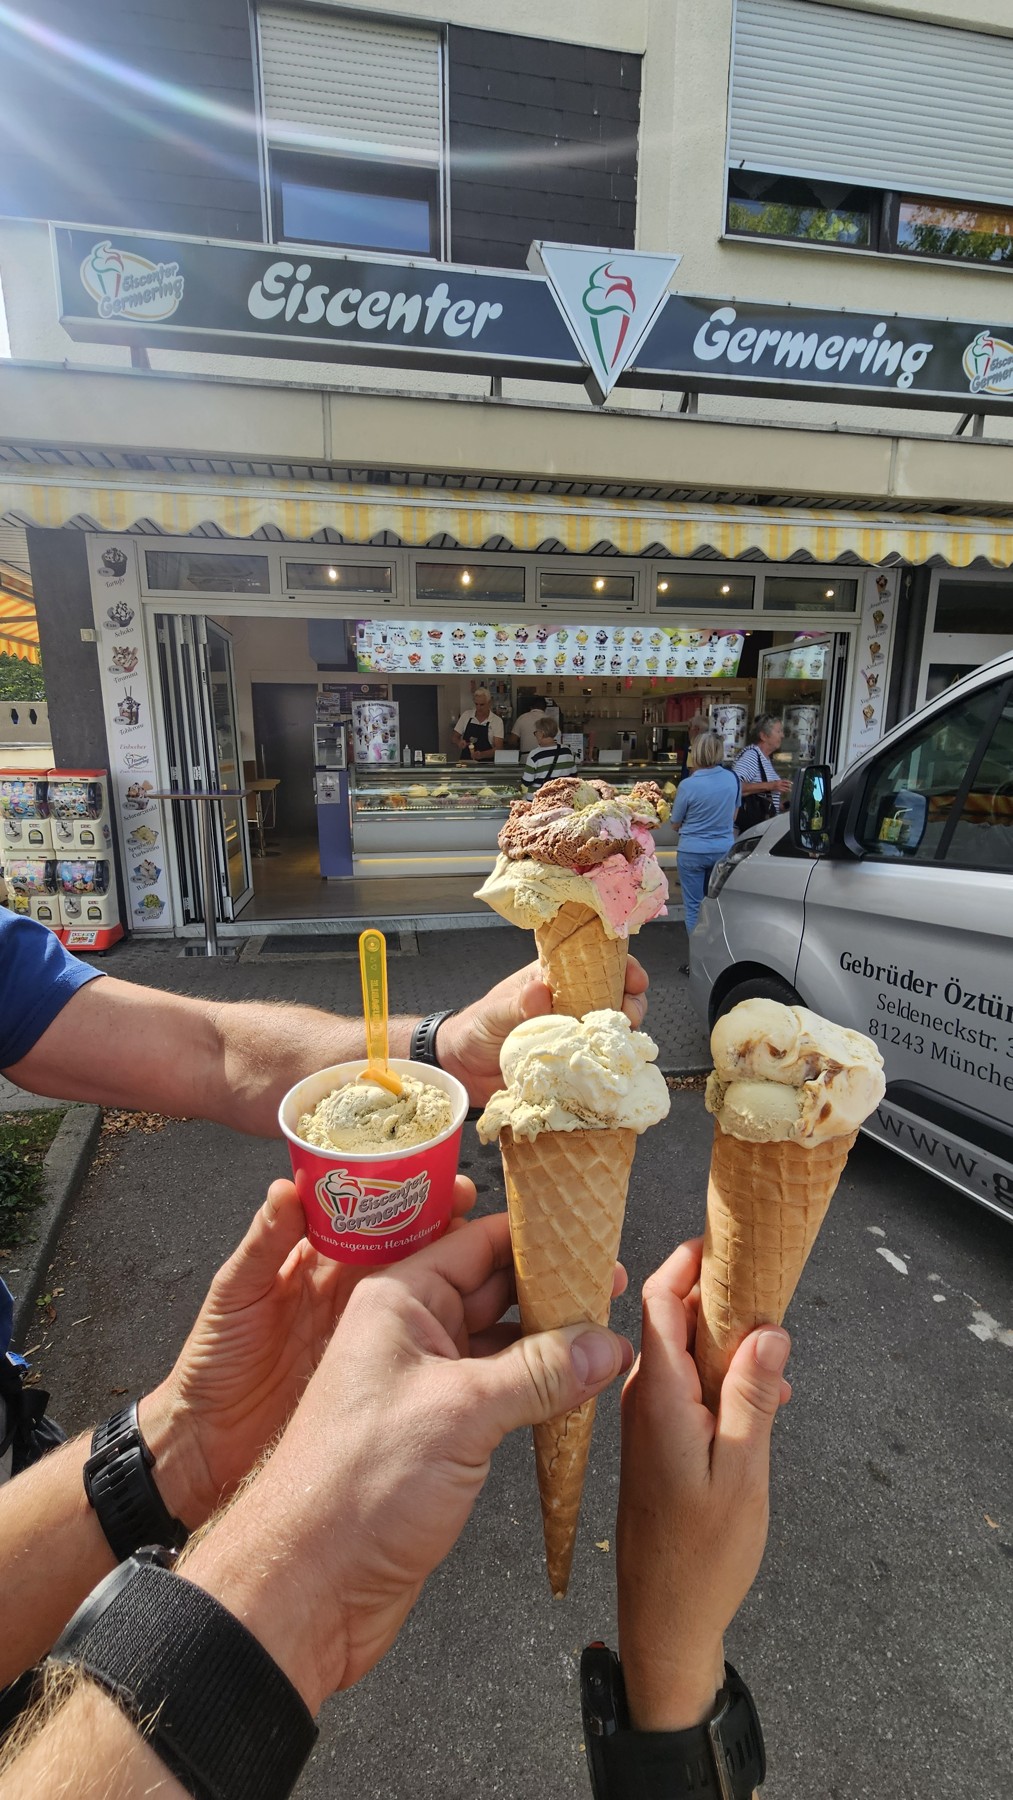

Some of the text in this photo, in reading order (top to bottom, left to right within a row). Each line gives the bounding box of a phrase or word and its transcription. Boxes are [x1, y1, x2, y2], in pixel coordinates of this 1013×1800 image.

[100, 278, 183, 316] Germering
[122, 264, 178, 292] Eiscenter
[248, 261, 504, 339] Eiscenter
[693, 306, 934, 389] Germering
[840, 951, 1013, 1024] Gebrüder Öztür
[876, 993, 998, 1052] Seldeneckstr.
[869, 1018, 1013, 1092] 81243 Münche
[334, 1183, 430, 1233] Germering
[358, 1173, 426, 1213] Eiscenter
[340, 1241, 383, 1252] eigener
[384, 1219, 441, 1249] Herstellung
